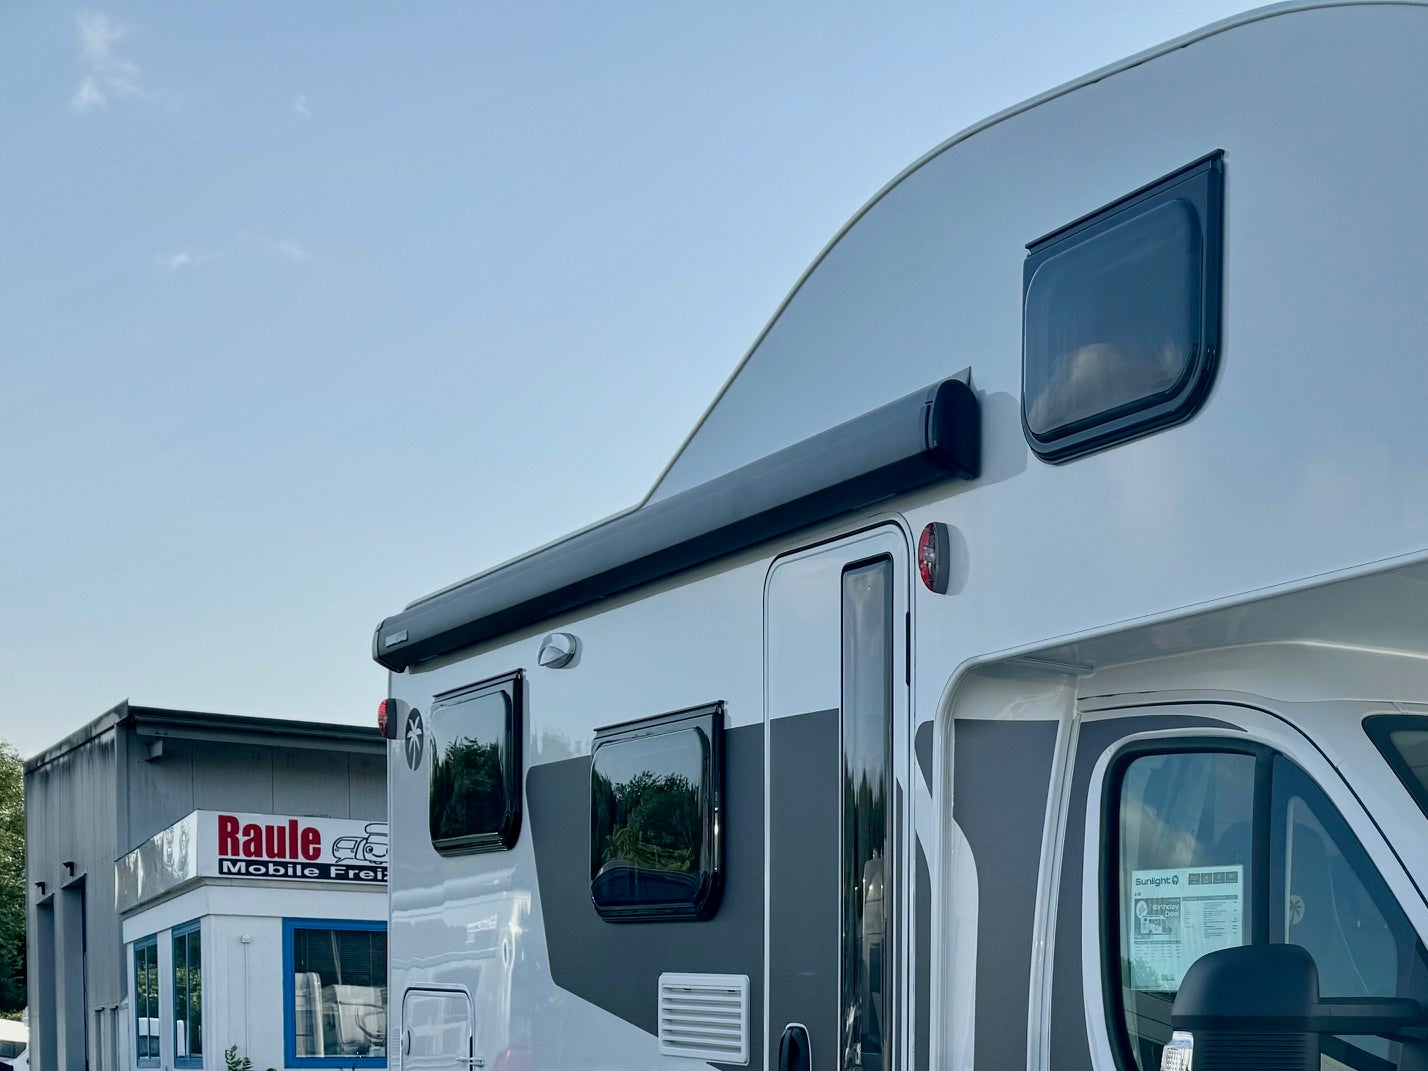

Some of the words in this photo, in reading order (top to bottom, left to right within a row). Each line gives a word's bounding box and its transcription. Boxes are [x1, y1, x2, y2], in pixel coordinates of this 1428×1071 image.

[218, 814, 322, 861] Raule
[222, 860, 320, 877] Mobile
[330, 866, 388, 880] Frei
[1135, 877, 1171, 887] Sunlight
